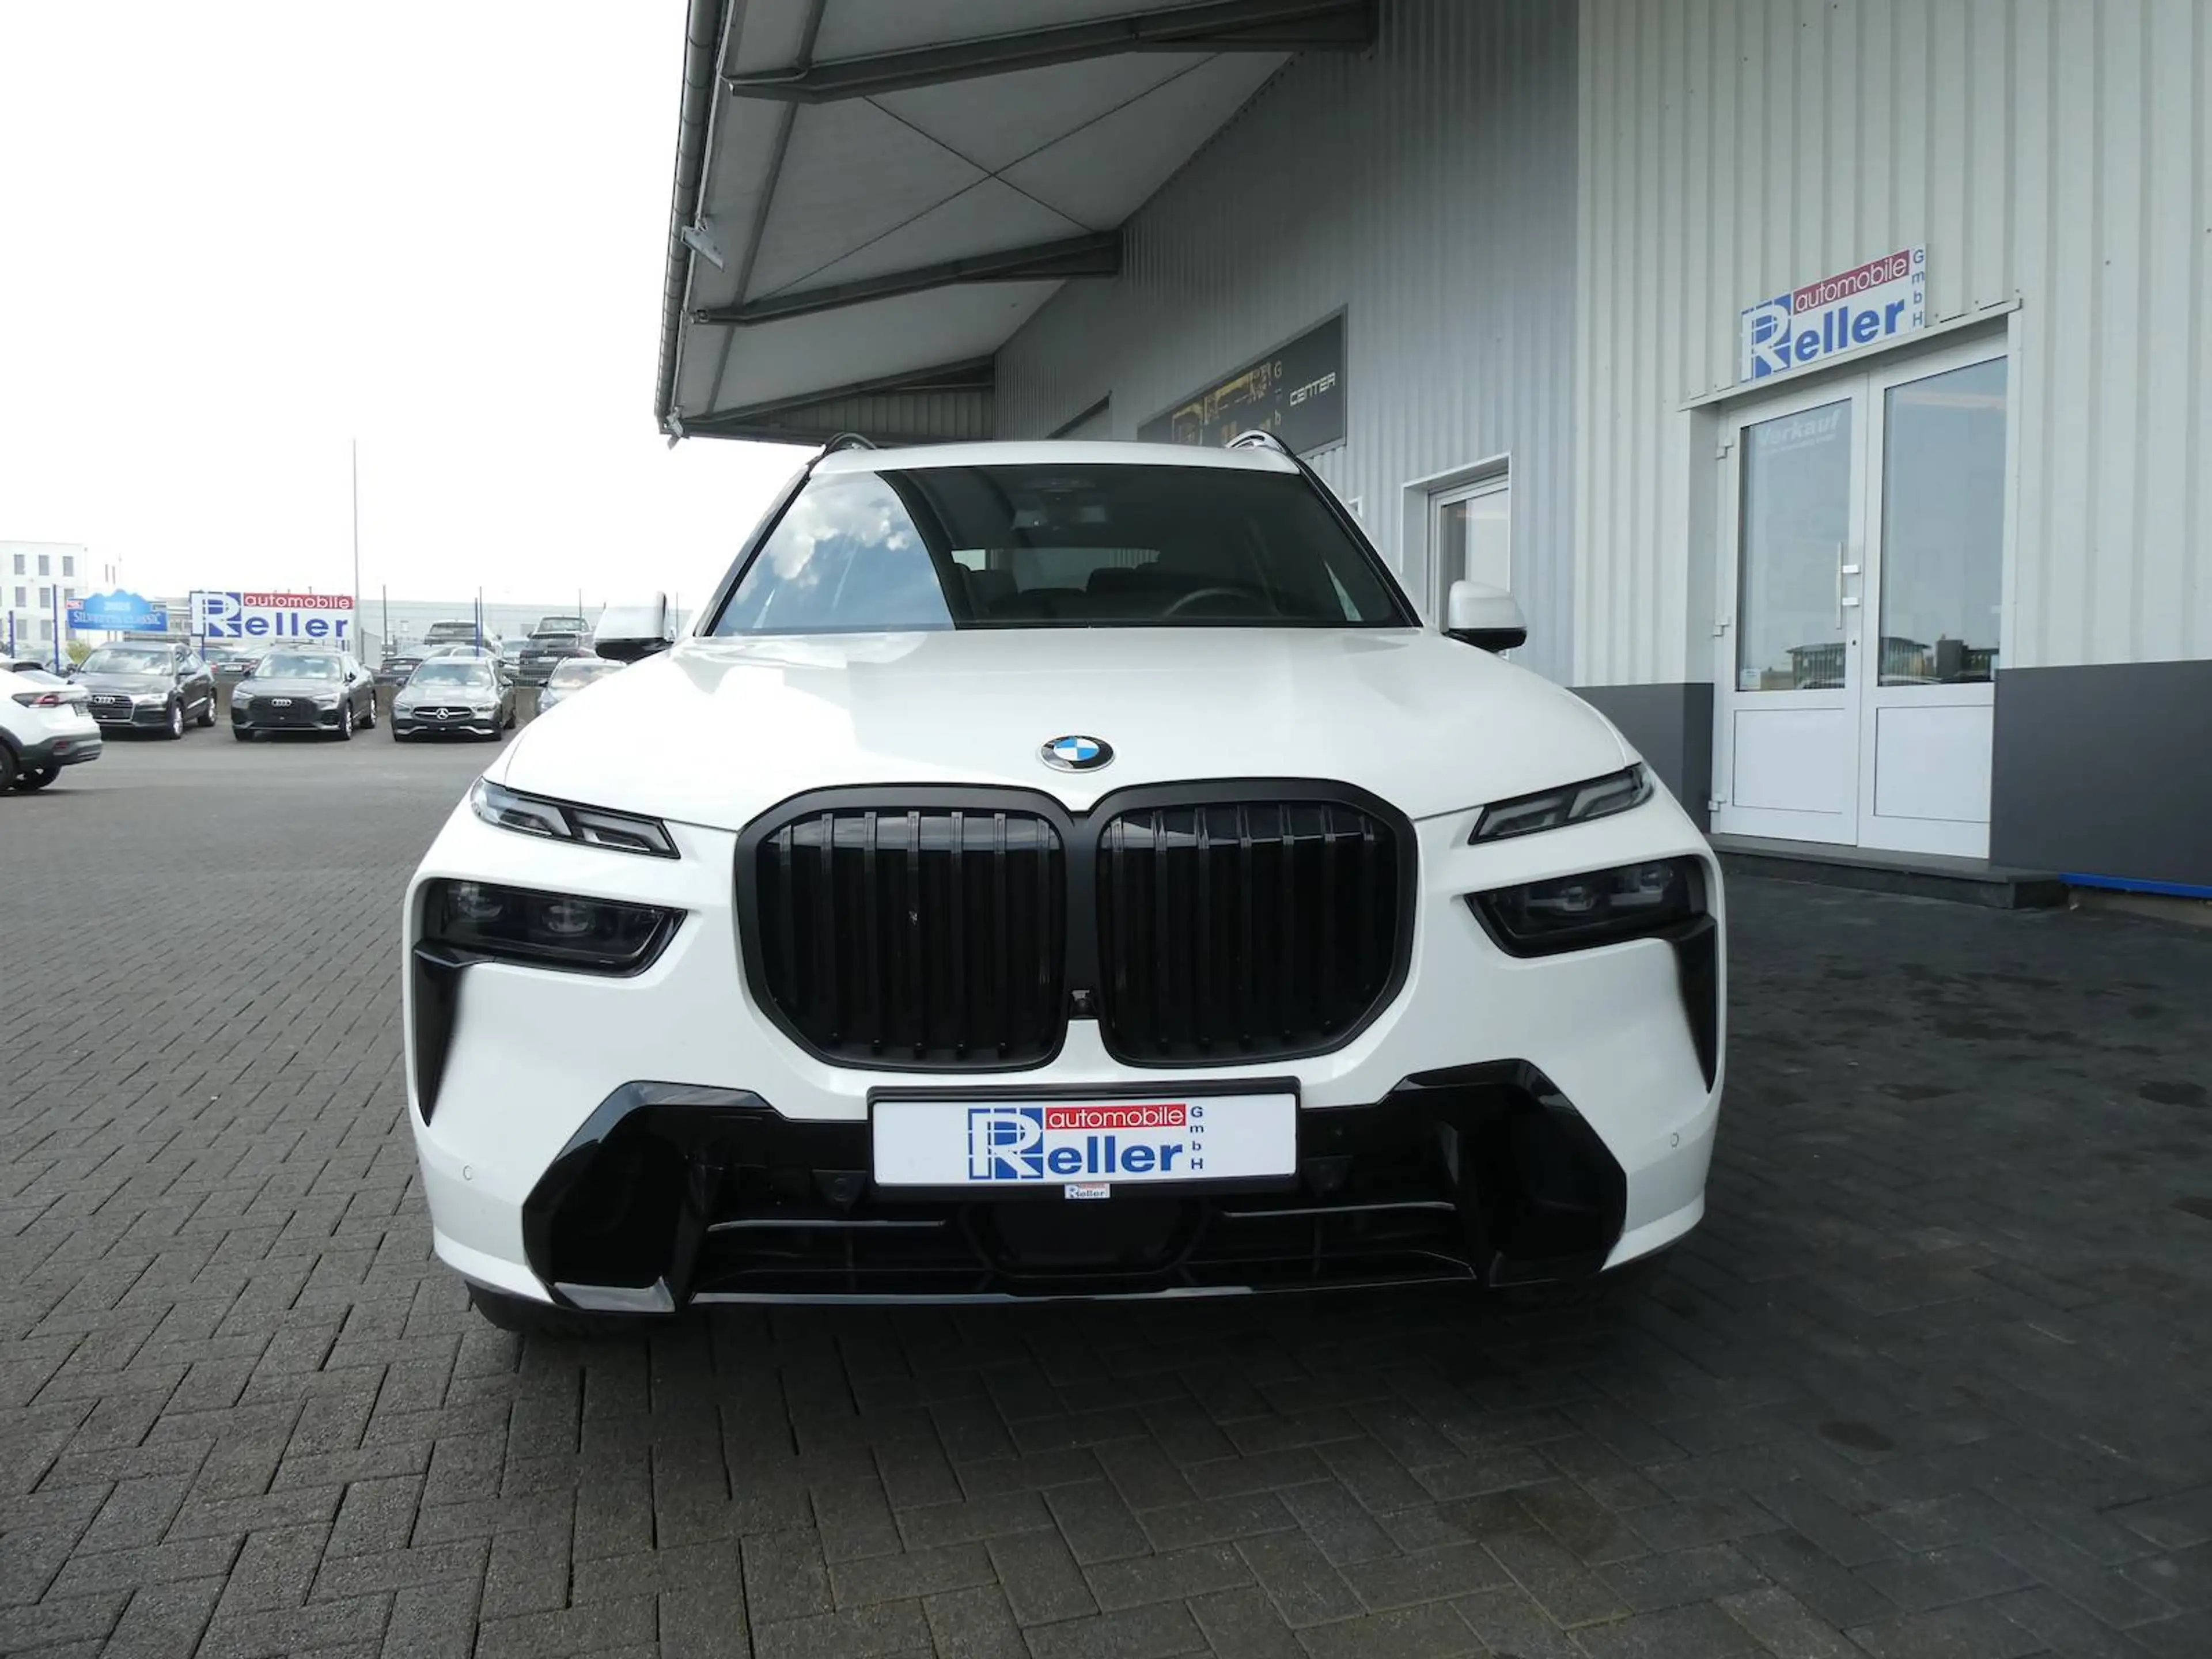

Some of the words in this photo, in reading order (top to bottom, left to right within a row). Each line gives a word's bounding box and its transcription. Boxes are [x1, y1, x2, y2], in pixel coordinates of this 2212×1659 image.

[1796, 257, 1907, 312] automobile
[1911, 249, 1925, 327] GmbH
[1741, 295, 1905, 382] Reller
[1289, 372, 1336, 407] CENTER
[190, 591, 349, 638] Reller
[245, 594, 349, 609] automobile
[968, 1107, 1183, 1180] Reller
[1049, 1106, 1184, 1128] automobile
[1190, 1106, 1204, 1170] GmbH
